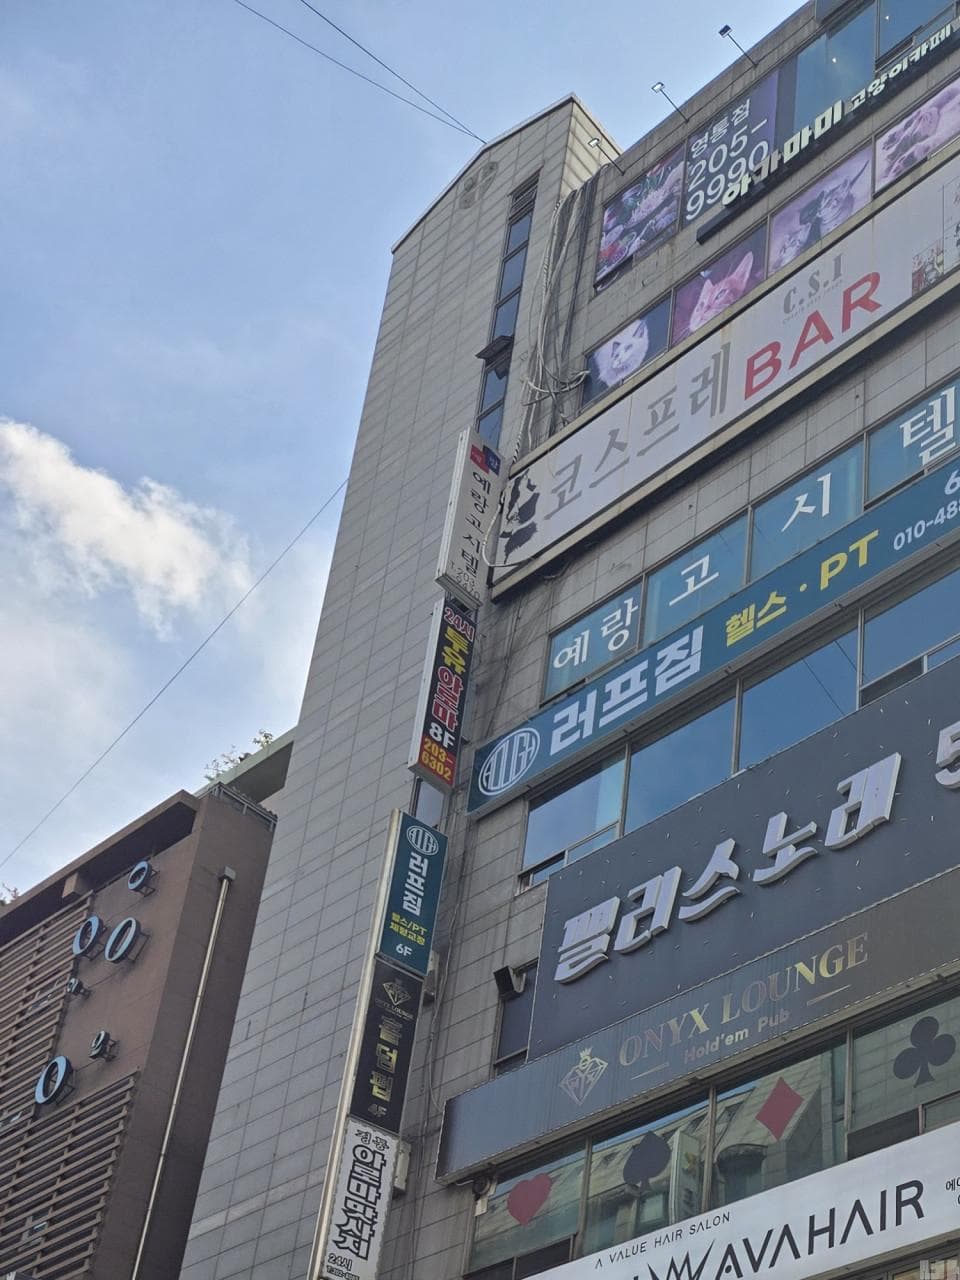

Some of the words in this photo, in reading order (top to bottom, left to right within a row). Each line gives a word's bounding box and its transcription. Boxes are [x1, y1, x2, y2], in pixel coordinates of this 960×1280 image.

[849, 23, 952, 112] 고양이카페
[689, 99, 752, 158] 영통점
[686, 140, 770, 221] 9990
[744, 271, 882, 400] BAR
[543, 341, 731, 521] 코스프레
[461, 470, 491, 577] 예랑고시텔
[725, 589, 787, 647] 헬스
[819, 529, 880, 591] PT
[441, 625, 471, 676] 투유
[444, 605, 475, 641] 24시
[552, 599, 640, 671] 예랑
[431, 665, 465, 733] 아로마
[549, 625, 703, 758] 러프짐
[421, 750, 452, 782] 6302
[422, 736, 455, 764] 203-
[428, 722, 456, 748] 8F
[403, 851, 429, 917] 러프짐
[554, 752, 902, 984] 팰리스노래
[396, 943, 413, 957] 6F
[619, 1006, 710, 1069] ONYX
[721, 932, 870, 1026] LOUNGE
[682, 1025, 750, 1067] Hold'em
[757, 1006, 791, 1035] Pub
[608, 1243, 648, 1265] VALUE
[653, 1231, 684, 1250] HAIR
[689, 1211, 732, 1238] SALON
